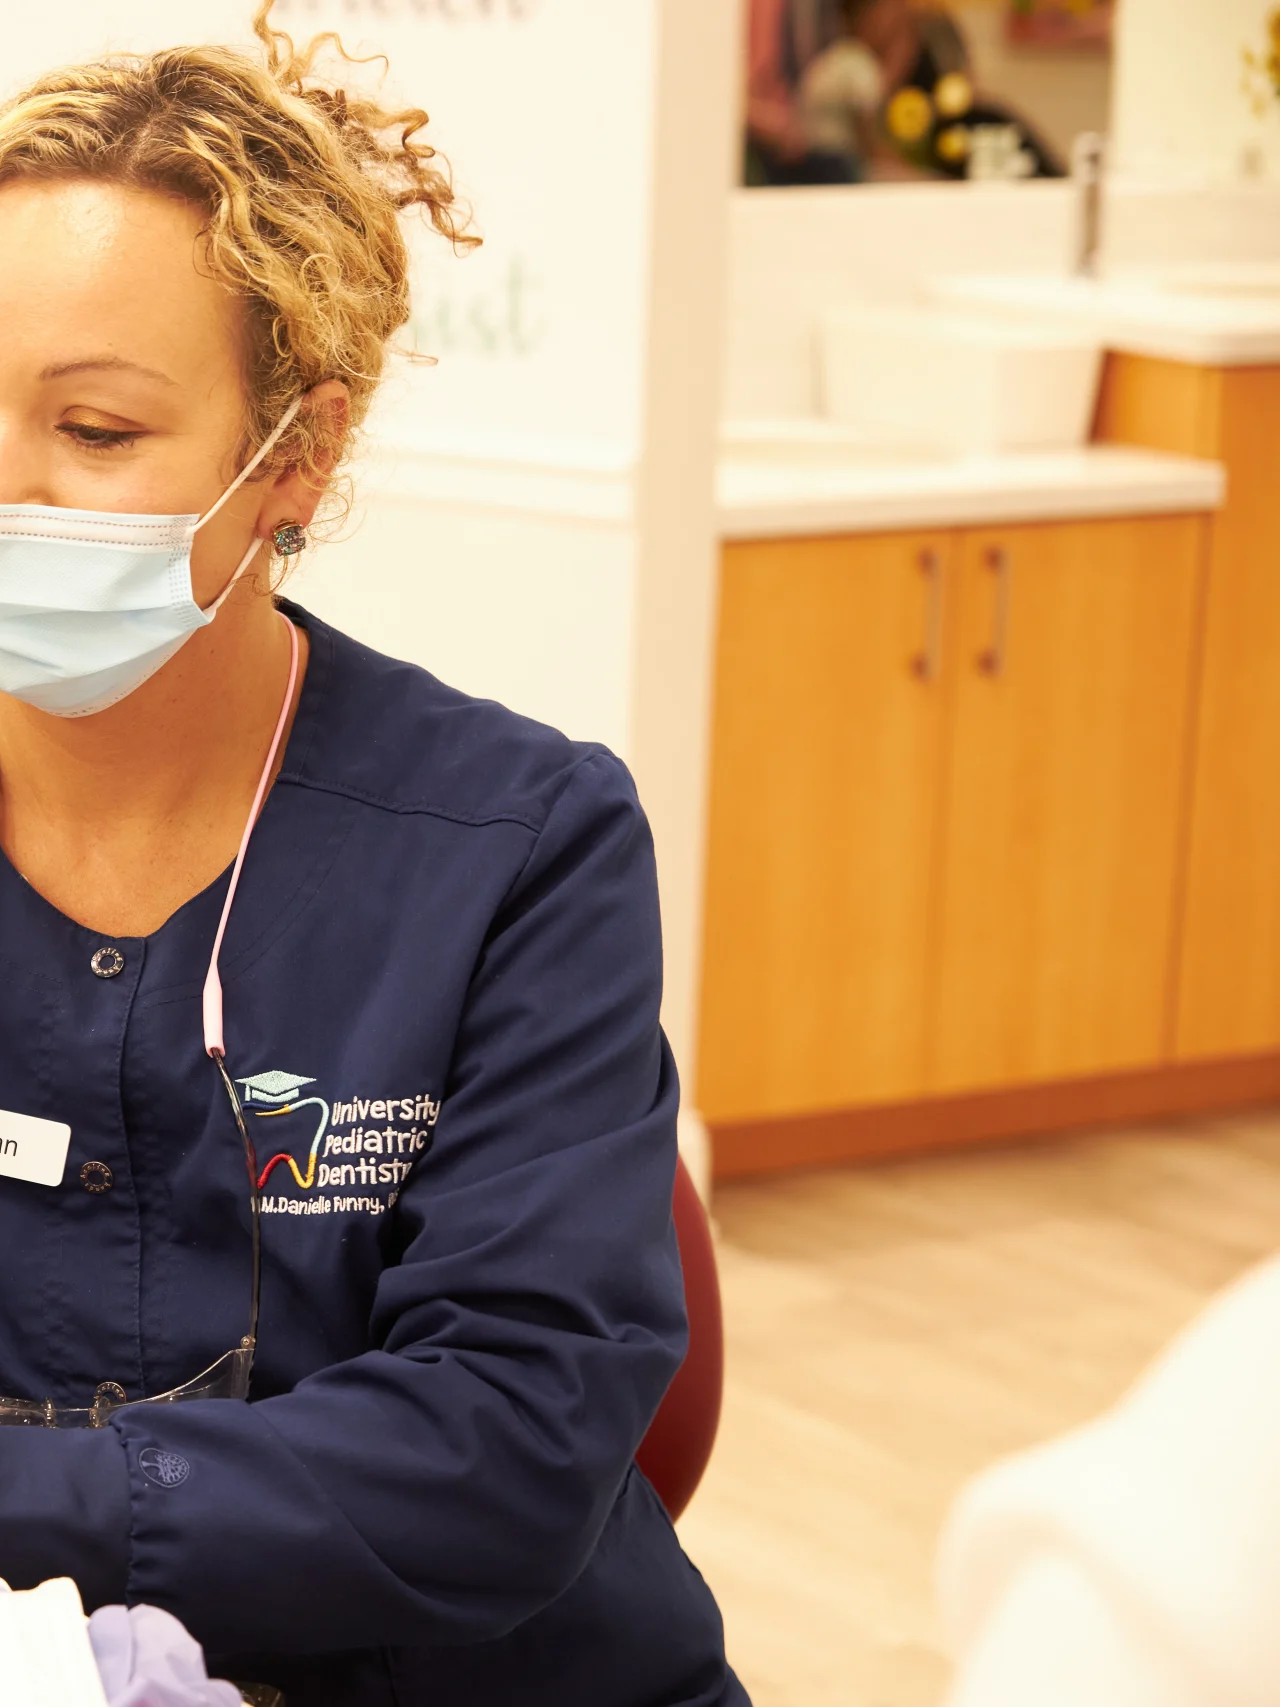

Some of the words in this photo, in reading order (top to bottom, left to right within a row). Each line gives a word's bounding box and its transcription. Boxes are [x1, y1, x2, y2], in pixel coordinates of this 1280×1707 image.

[330, 1094, 441, 1126] University
[323, 1126, 428, 1158] Pediatric
[317, 1157, 412, 1188] Dentistr
[333, 1195, 385, 1216] Funny,
